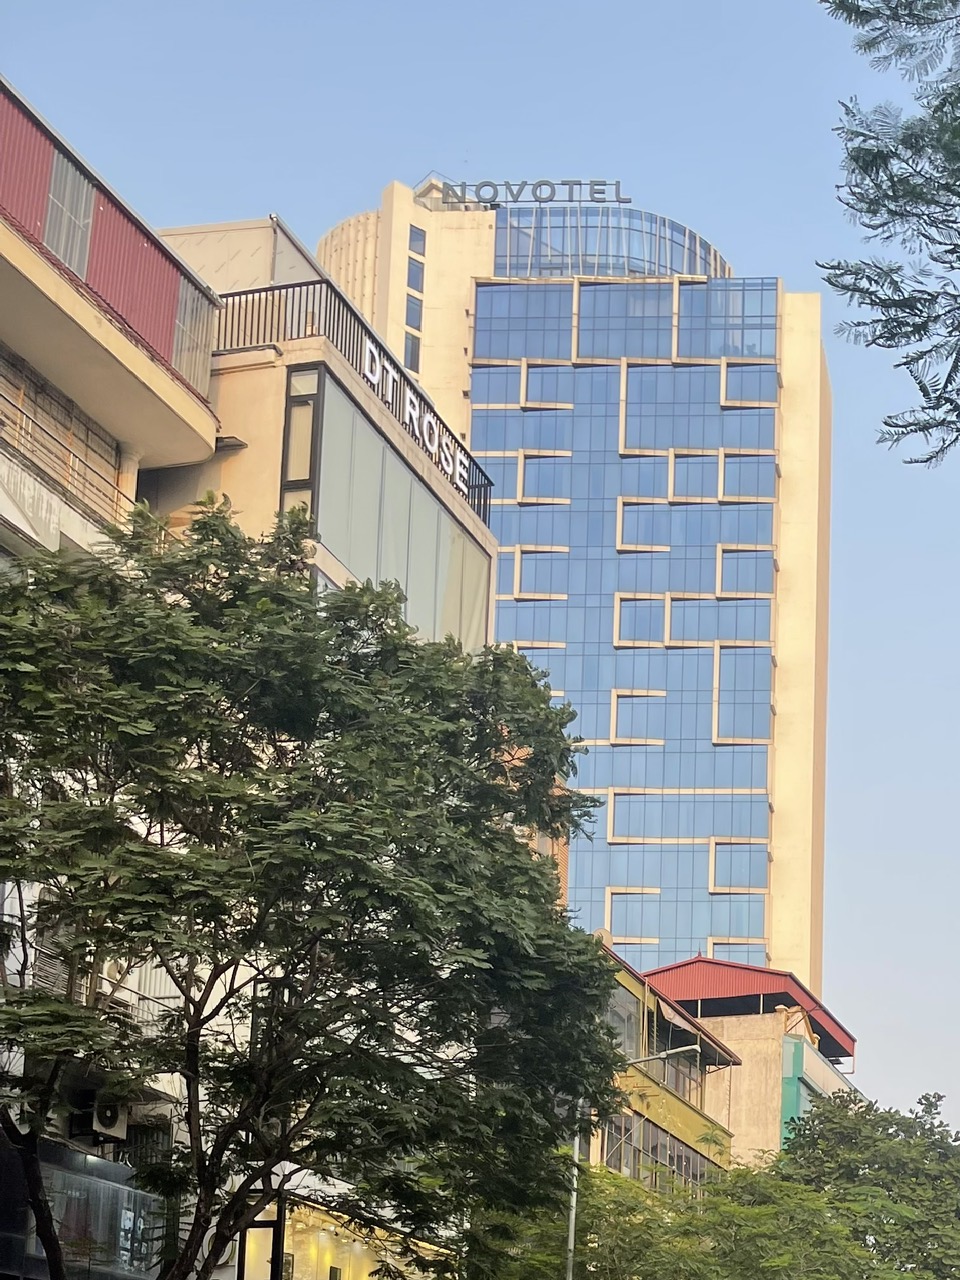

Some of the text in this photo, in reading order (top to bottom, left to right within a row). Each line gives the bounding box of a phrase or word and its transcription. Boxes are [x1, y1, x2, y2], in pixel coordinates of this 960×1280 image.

[442, 180, 632, 203] NOVOTEL
[364, 337, 469, 495] DT ROSE
